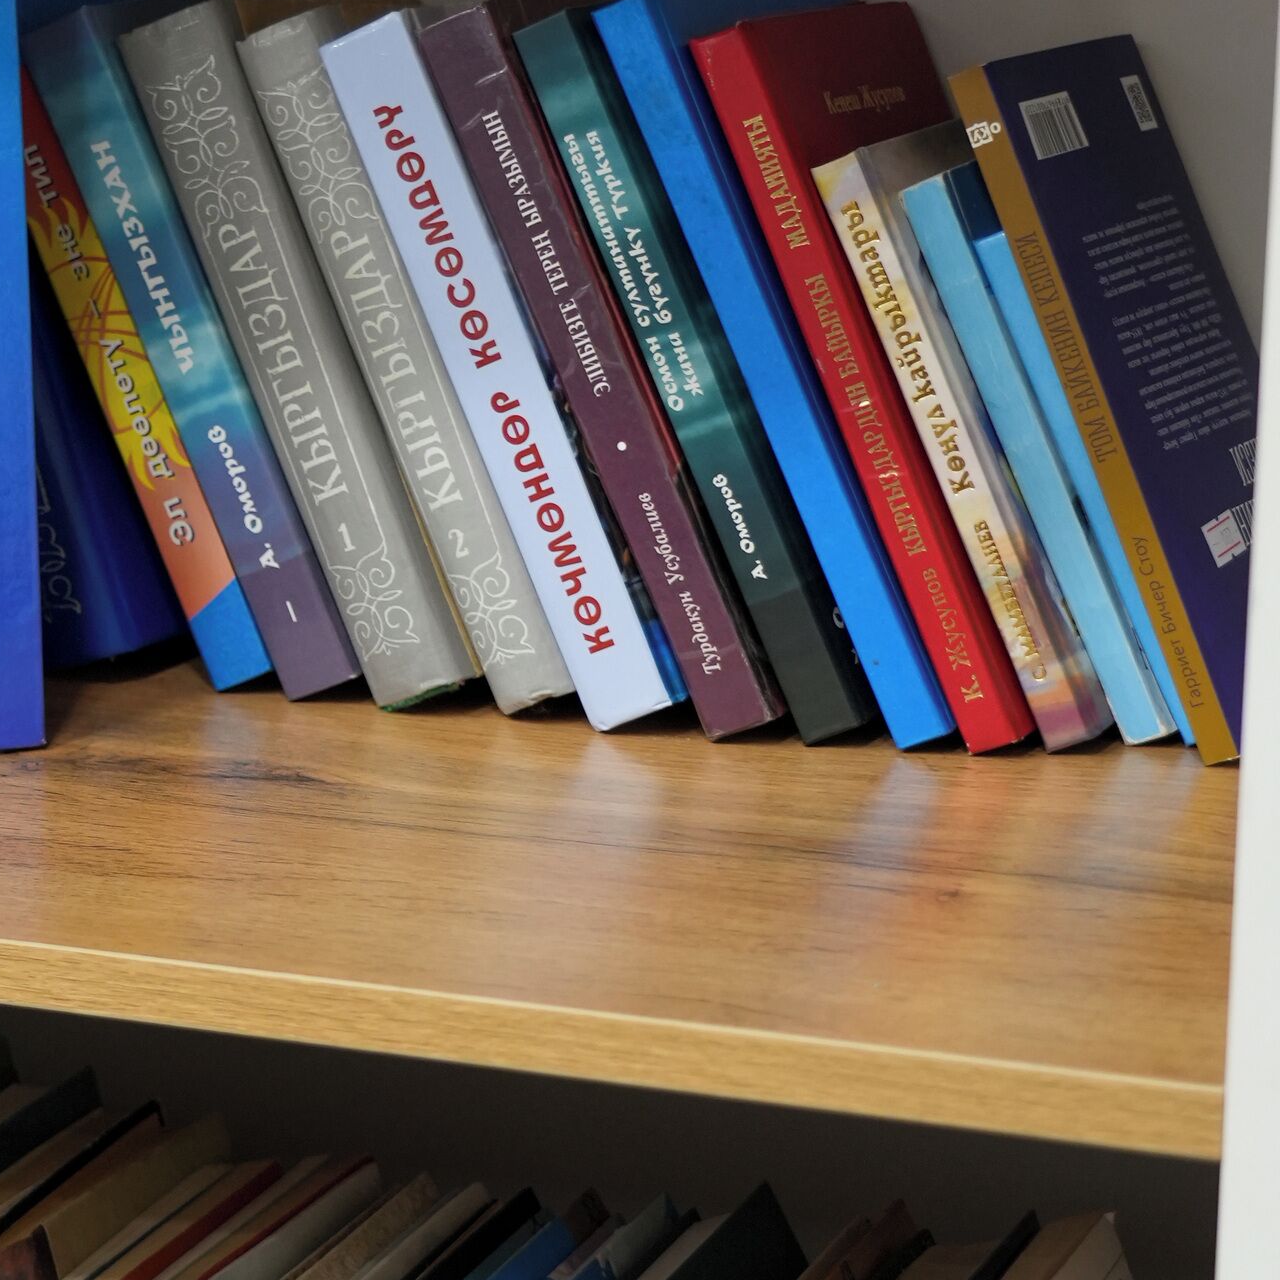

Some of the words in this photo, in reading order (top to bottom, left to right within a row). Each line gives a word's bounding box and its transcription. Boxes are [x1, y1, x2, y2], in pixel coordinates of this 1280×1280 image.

[25, 143, 60, 209] тил
[481, 110, 543, 229] ЫРАЗЫМЫН
[586, 131, 628, 221] Түркия
[742, 114, 810, 250] МАДАНИЯТЫ
[55, 222, 90, 280] эне
[373, 104, 503, 369] КӨСӨМДӨРҮ
[530, 233, 569, 296] ТЕРЕҢ
[624, 225, 672, 326] бүгүнкү
[219, 224, 347, 506] КЫРГЫЗДАР
[559, 297, 611, 398] ЭЛИБИЗГЕ
[668, 331, 704, 396] жана
[805, 273, 860, 379] БАЙЫРКЫ
[1045, 310, 1101, 398] БАЙКЕНИН
[99, 339, 176, 479] дөөлөтү
[330, 233, 462, 511] КЫРГЫЗДАР
[645, 335, 684, 411] Осмон
[846, 381, 928, 556] КЫРГЫЗДАРДЫН
[930, 401, 975, 497] Көңүл
[1083, 403, 1118, 464] ТОМ
[162, 496, 196, 547] Эл
[207, 425, 264, 535] Оморов
[489, 390, 616, 654] КӨЧМӨНДӨР
[712, 473, 755, 556] Оморов
[258, 543, 281, 571] А.
[337, 524, 356, 551] 1
[448, 529, 469, 559] 2
[637, 492, 686, 586] Усубалиев
[751, 561, 768, 581] А.
[1131, 536, 1161, 579] Стоу
[679, 590, 721, 675] Турдакун
[922, 567, 972, 671] Жусупов
[1149, 579, 1177, 634] Бичер
[963, 676, 984, 702] К.
[1165, 633, 1204, 708] Гарриет
